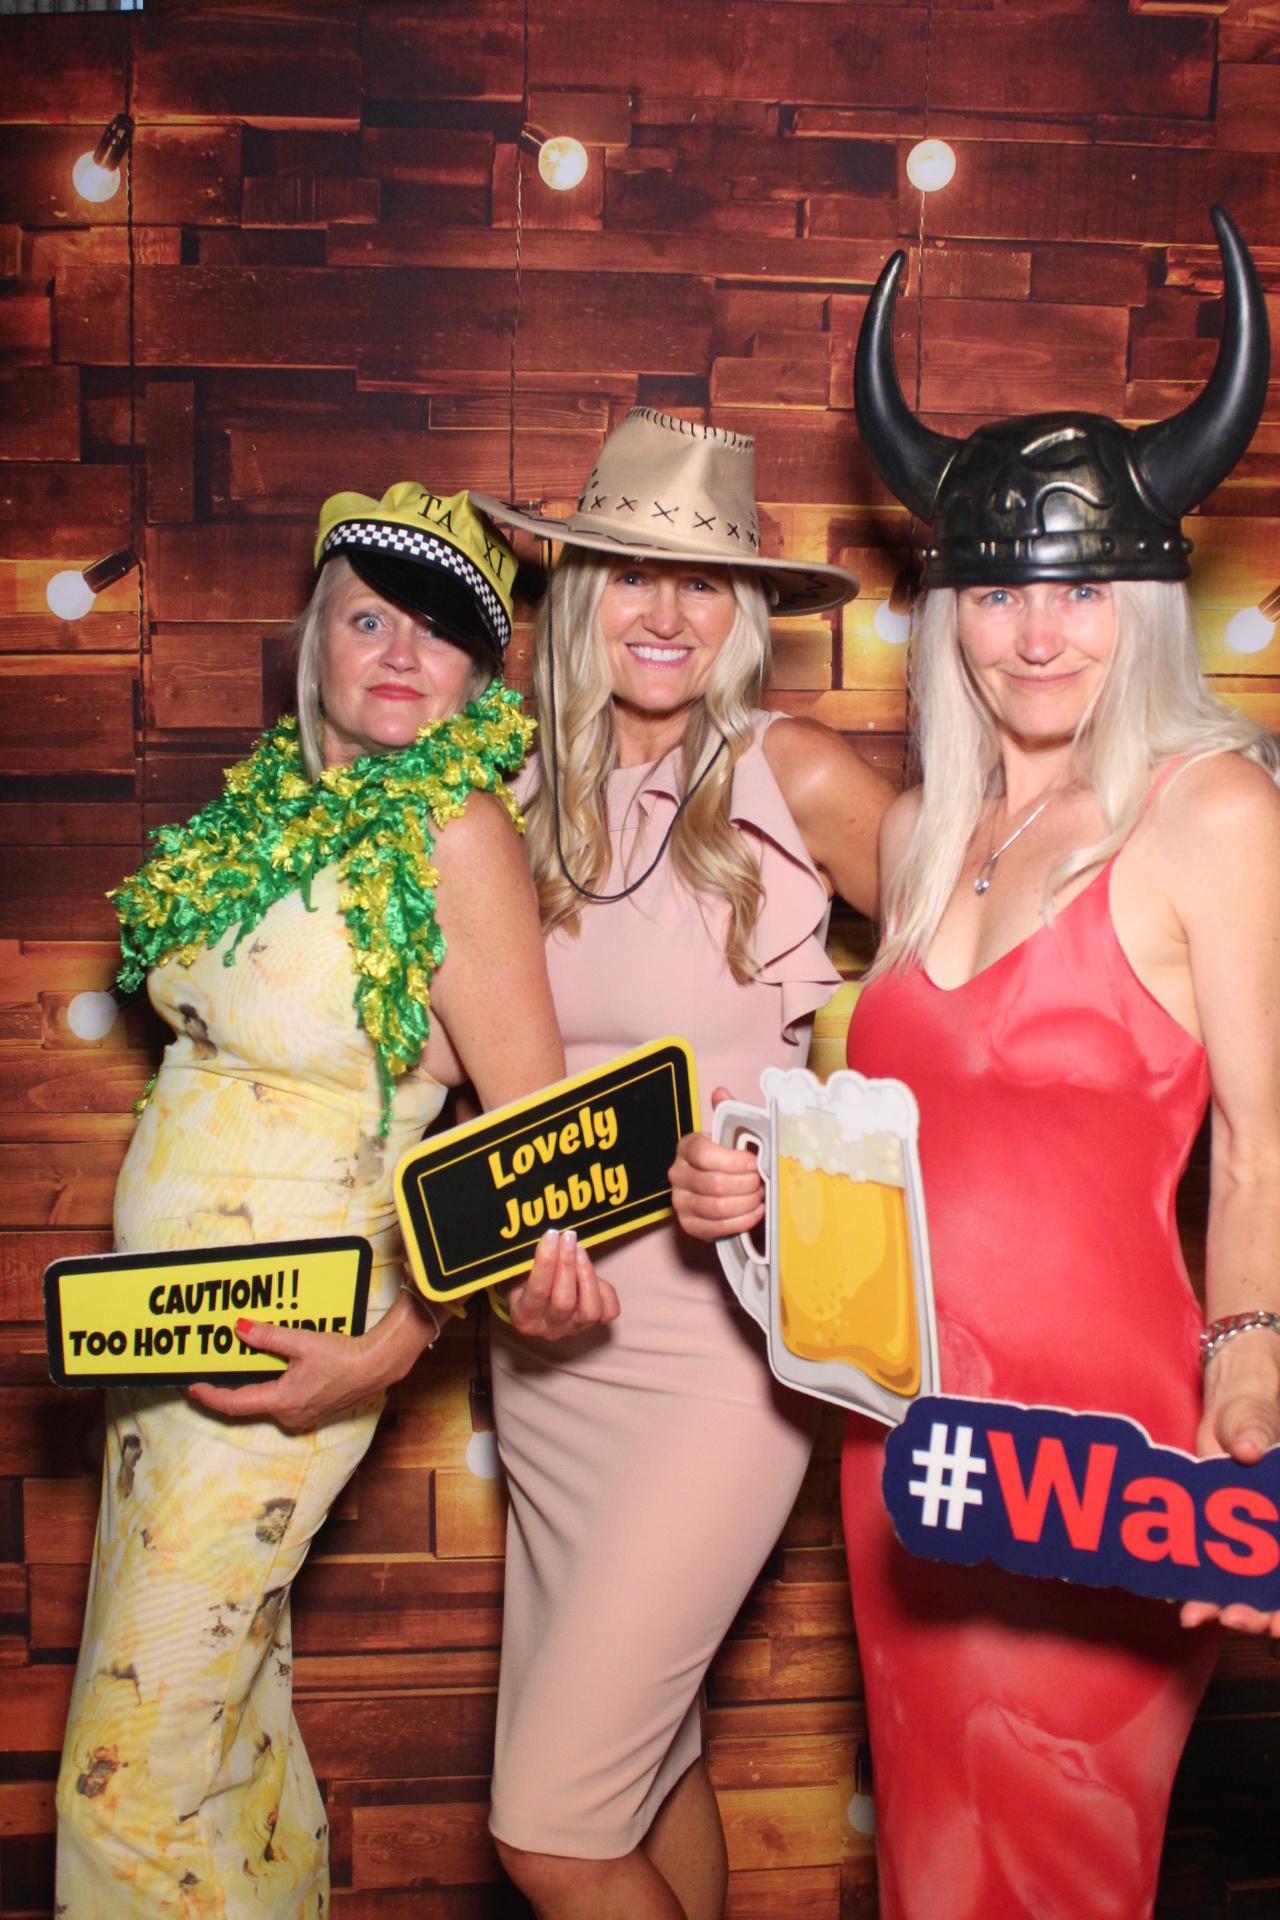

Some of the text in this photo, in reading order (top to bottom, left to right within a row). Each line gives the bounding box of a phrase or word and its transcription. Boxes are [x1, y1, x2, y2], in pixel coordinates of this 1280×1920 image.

[417, 493, 506, 581] TAXI
[487, 1106, 618, 1189] Lovely
[499, 1163, 629, 1239] Jubbly
[149, 1269, 299, 1315] CAUTION!!
[69, 1331, 127, 1357] TOO
[134, 1327, 191, 1356] HOT
[197, 1325, 233, 1355] TO
